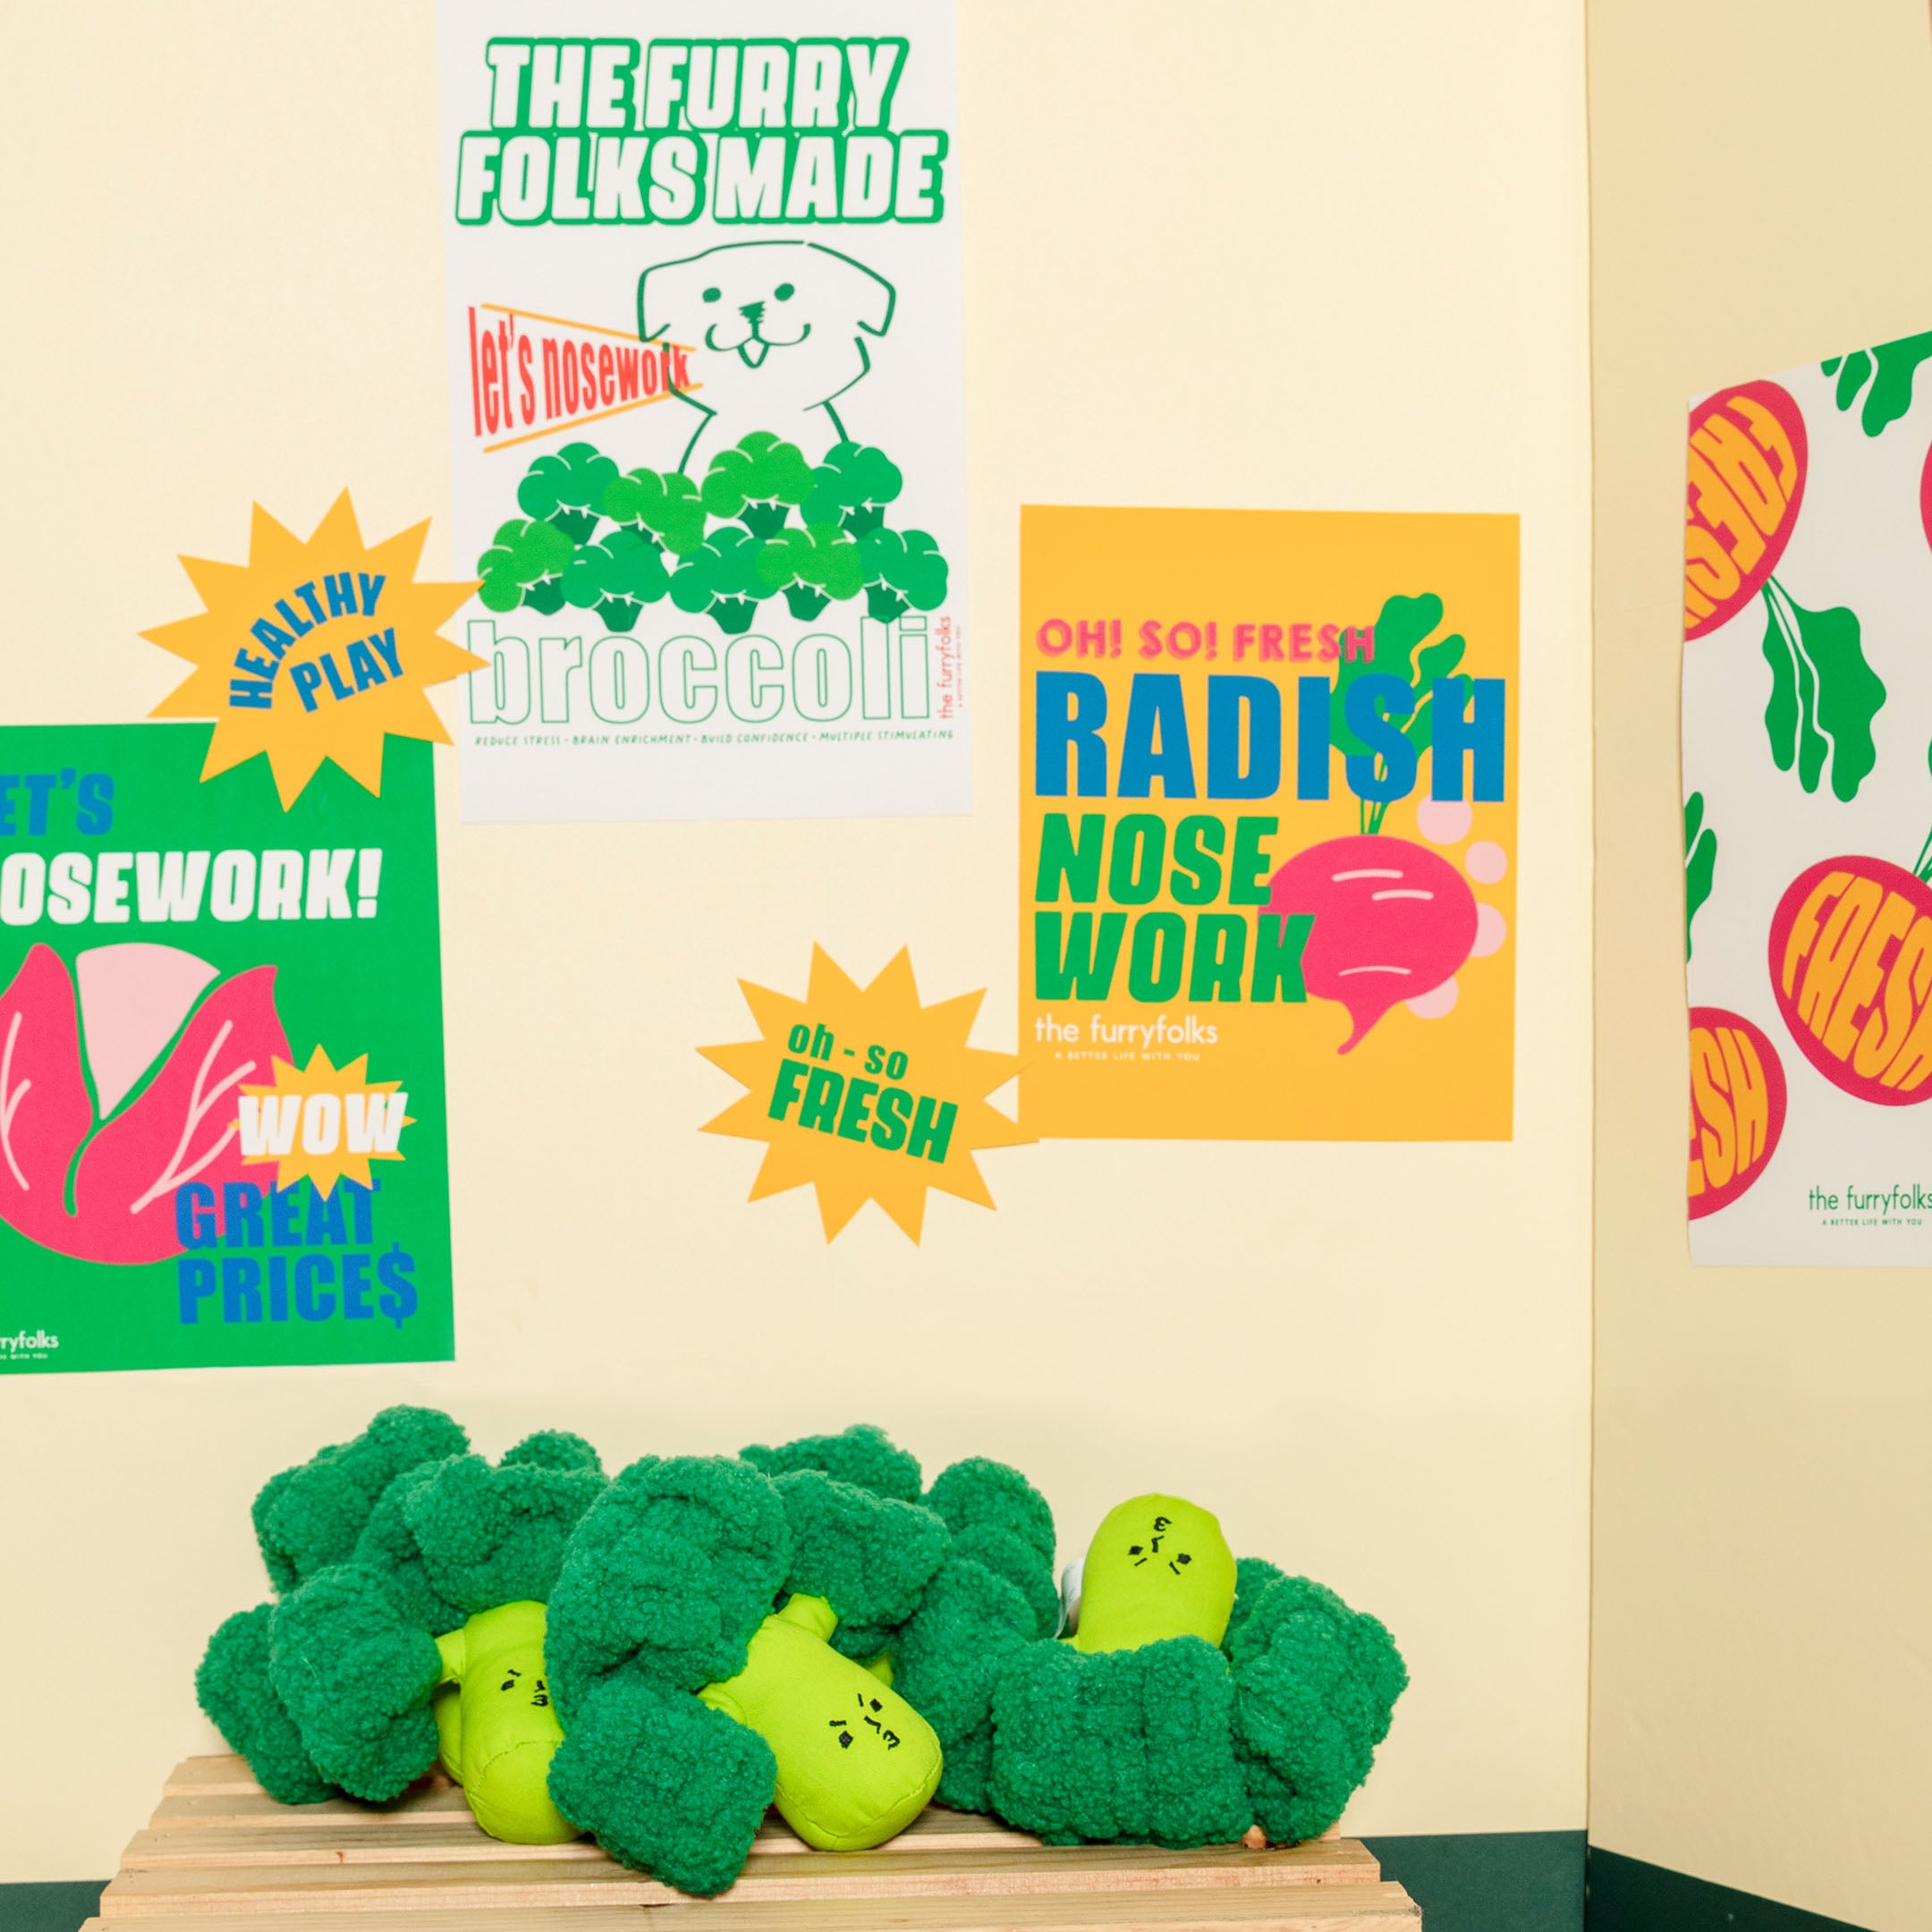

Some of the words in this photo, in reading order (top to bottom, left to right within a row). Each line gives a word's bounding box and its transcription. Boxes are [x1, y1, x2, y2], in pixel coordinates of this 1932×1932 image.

[487, 38, 640, 132] THE
[644, 38, 909, 133] FURRY
[456, 130, 708, 226] FOLKS
[713, 130, 948, 225] MADE
[469, 306, 536, 436] let's
[542, 337, 691, 419] nosework
[229, 572, 386, 709] HEALTHY
[289, 627, 403, 713] PLAY
[467, 615, 930, 724] broccoli
[1036, 617, 1123, 658] OH!
[1138, 619, 1218, 662] SO!
[1233, 623, 1376, 664] FRESH
[572, 735, 610, 745] BRAIN
[615, 733, 691, 744] ENRICHMENT
[700, 733, 733, 743] BUILD
[737, 733, 809, 743] CONFIDENCE
[819, 731, 873, 741] MULTIPLE
[877, 730, 953, 741] STIMULATING
[1035, 670, 1505, 803] RADISH
[1034, 812, 1279, 906] NOSE
[1034, 911, 1317, 1004] WORK
[788, 1023, 835, 1062] oh
[864, 1045, 909, 1080] so
[1035, 1013, 1080, 1042] the
[1089, 1013, 1219, 1050] furryfolks
[237, 1092, 409, 1156] WOW
[767, 1058, 959, 1164] FRESH
[175, 1178, 382, 1250] GREAT
[1809, 1184, 1839, 1210] the
[178, 1241, 419, 1329] PRICE$
